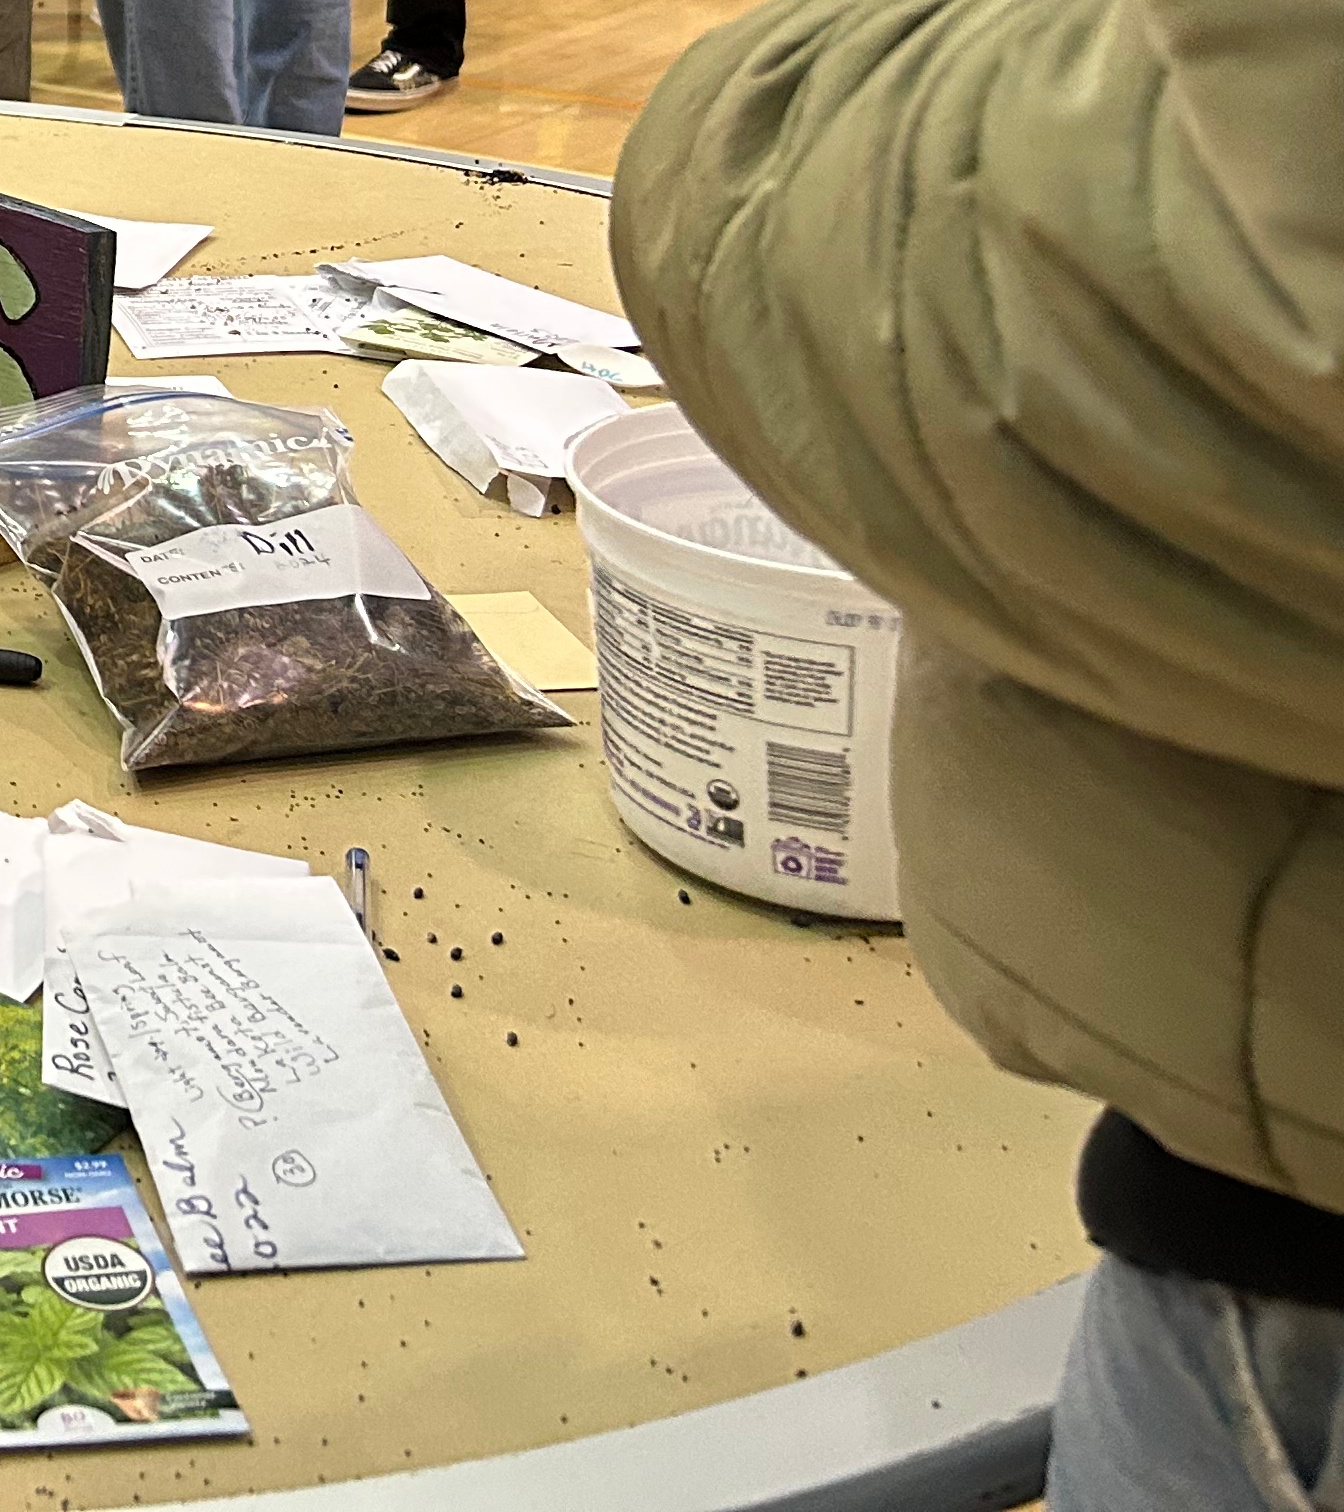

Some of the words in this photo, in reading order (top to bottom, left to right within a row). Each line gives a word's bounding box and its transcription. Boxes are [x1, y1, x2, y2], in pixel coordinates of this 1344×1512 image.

[237, 528, 315, 557] Dill
[200, 984, 226, 1012] Bee
[52, 1023, 94, 1080] Rose
[261, 1030, 320, 1075] Wild
[163, 1117, 217, 1218] Balm
[201, 1215, 231, 1271] ee
[232, 1174, 279, 1270] 022
[64, 1252, 127, 1272] USDA
[64, 1269, 142, 1293] ORGANIC
